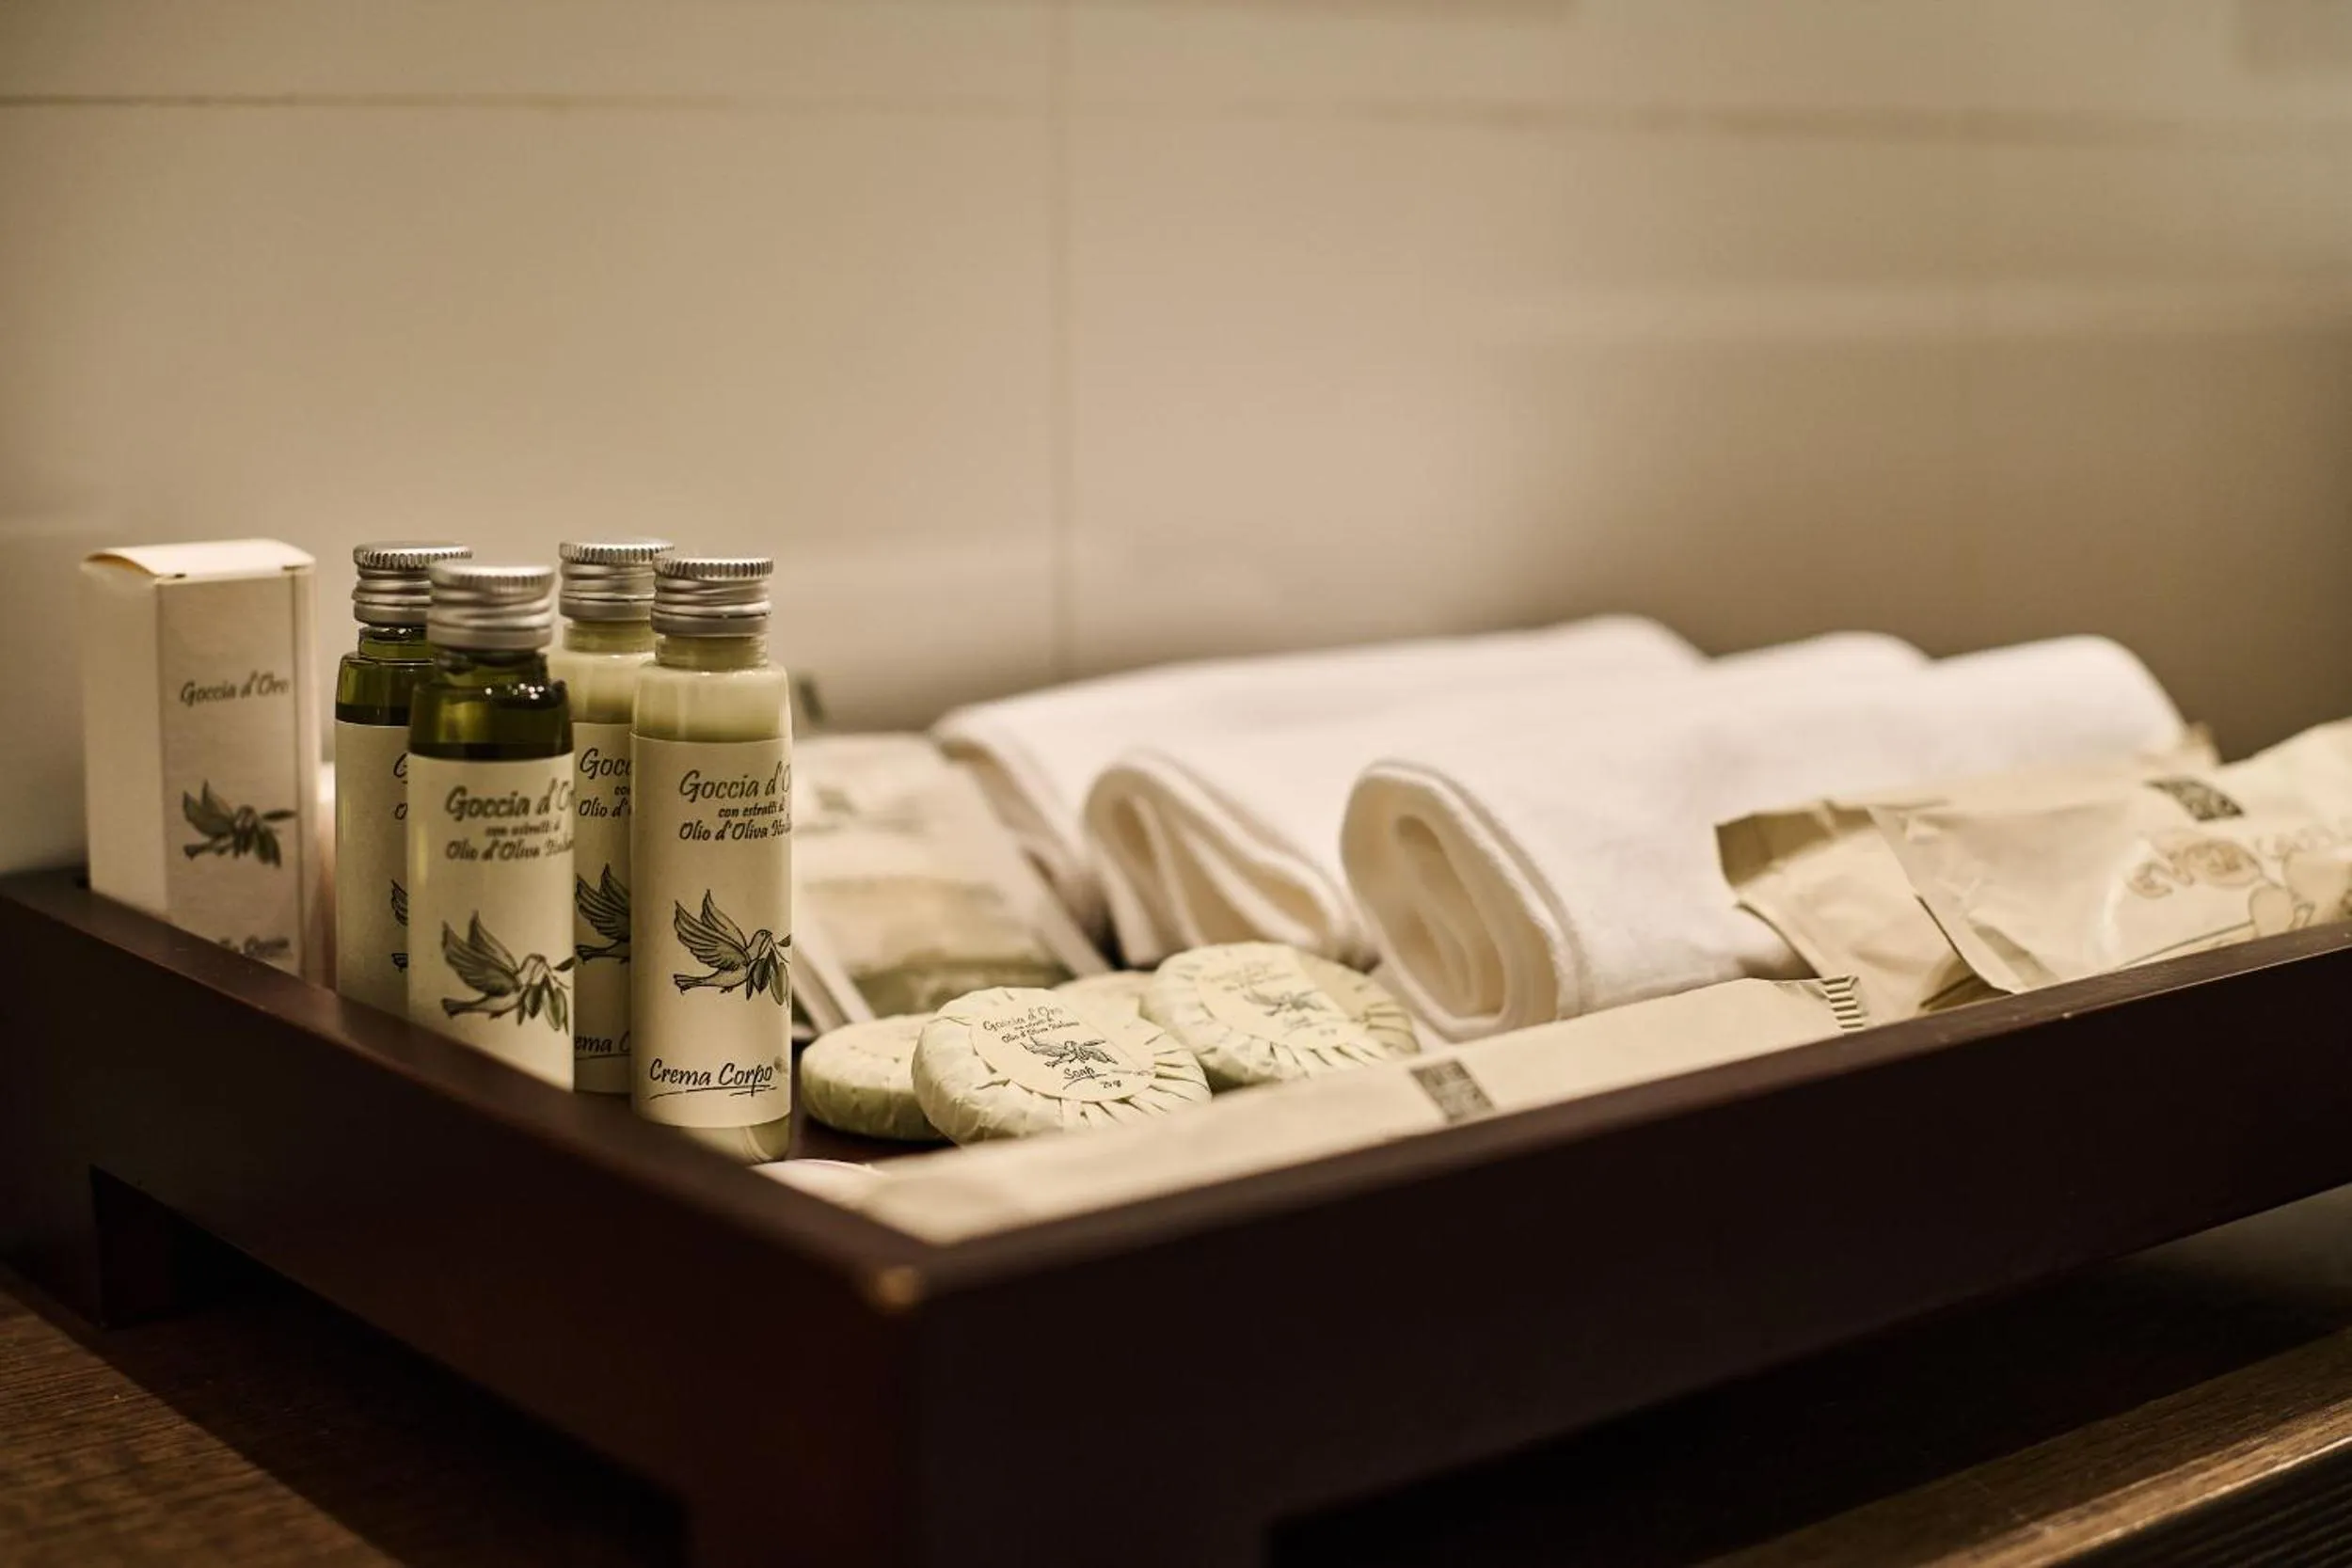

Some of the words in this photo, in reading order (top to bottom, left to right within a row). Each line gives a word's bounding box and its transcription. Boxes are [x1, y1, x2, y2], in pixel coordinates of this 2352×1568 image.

[180, 679, 236, 707] Goccia
[679, 769, 758, 803] Goccia
[445, 784, 531, 822] Goccia
[579, 797, 608, 818] Olio
[718, 807, 739, 818] con
[679, 819, 710, 841] Olio
[714, 819, 768, 841] d'Oliva
[446, 838, 479, 861] Olio
[649, 1058, 711, 1086] Crema
[718, 1063, 773, 1097] Corpo
[1063, 1066, 1095, 1079] Soap
